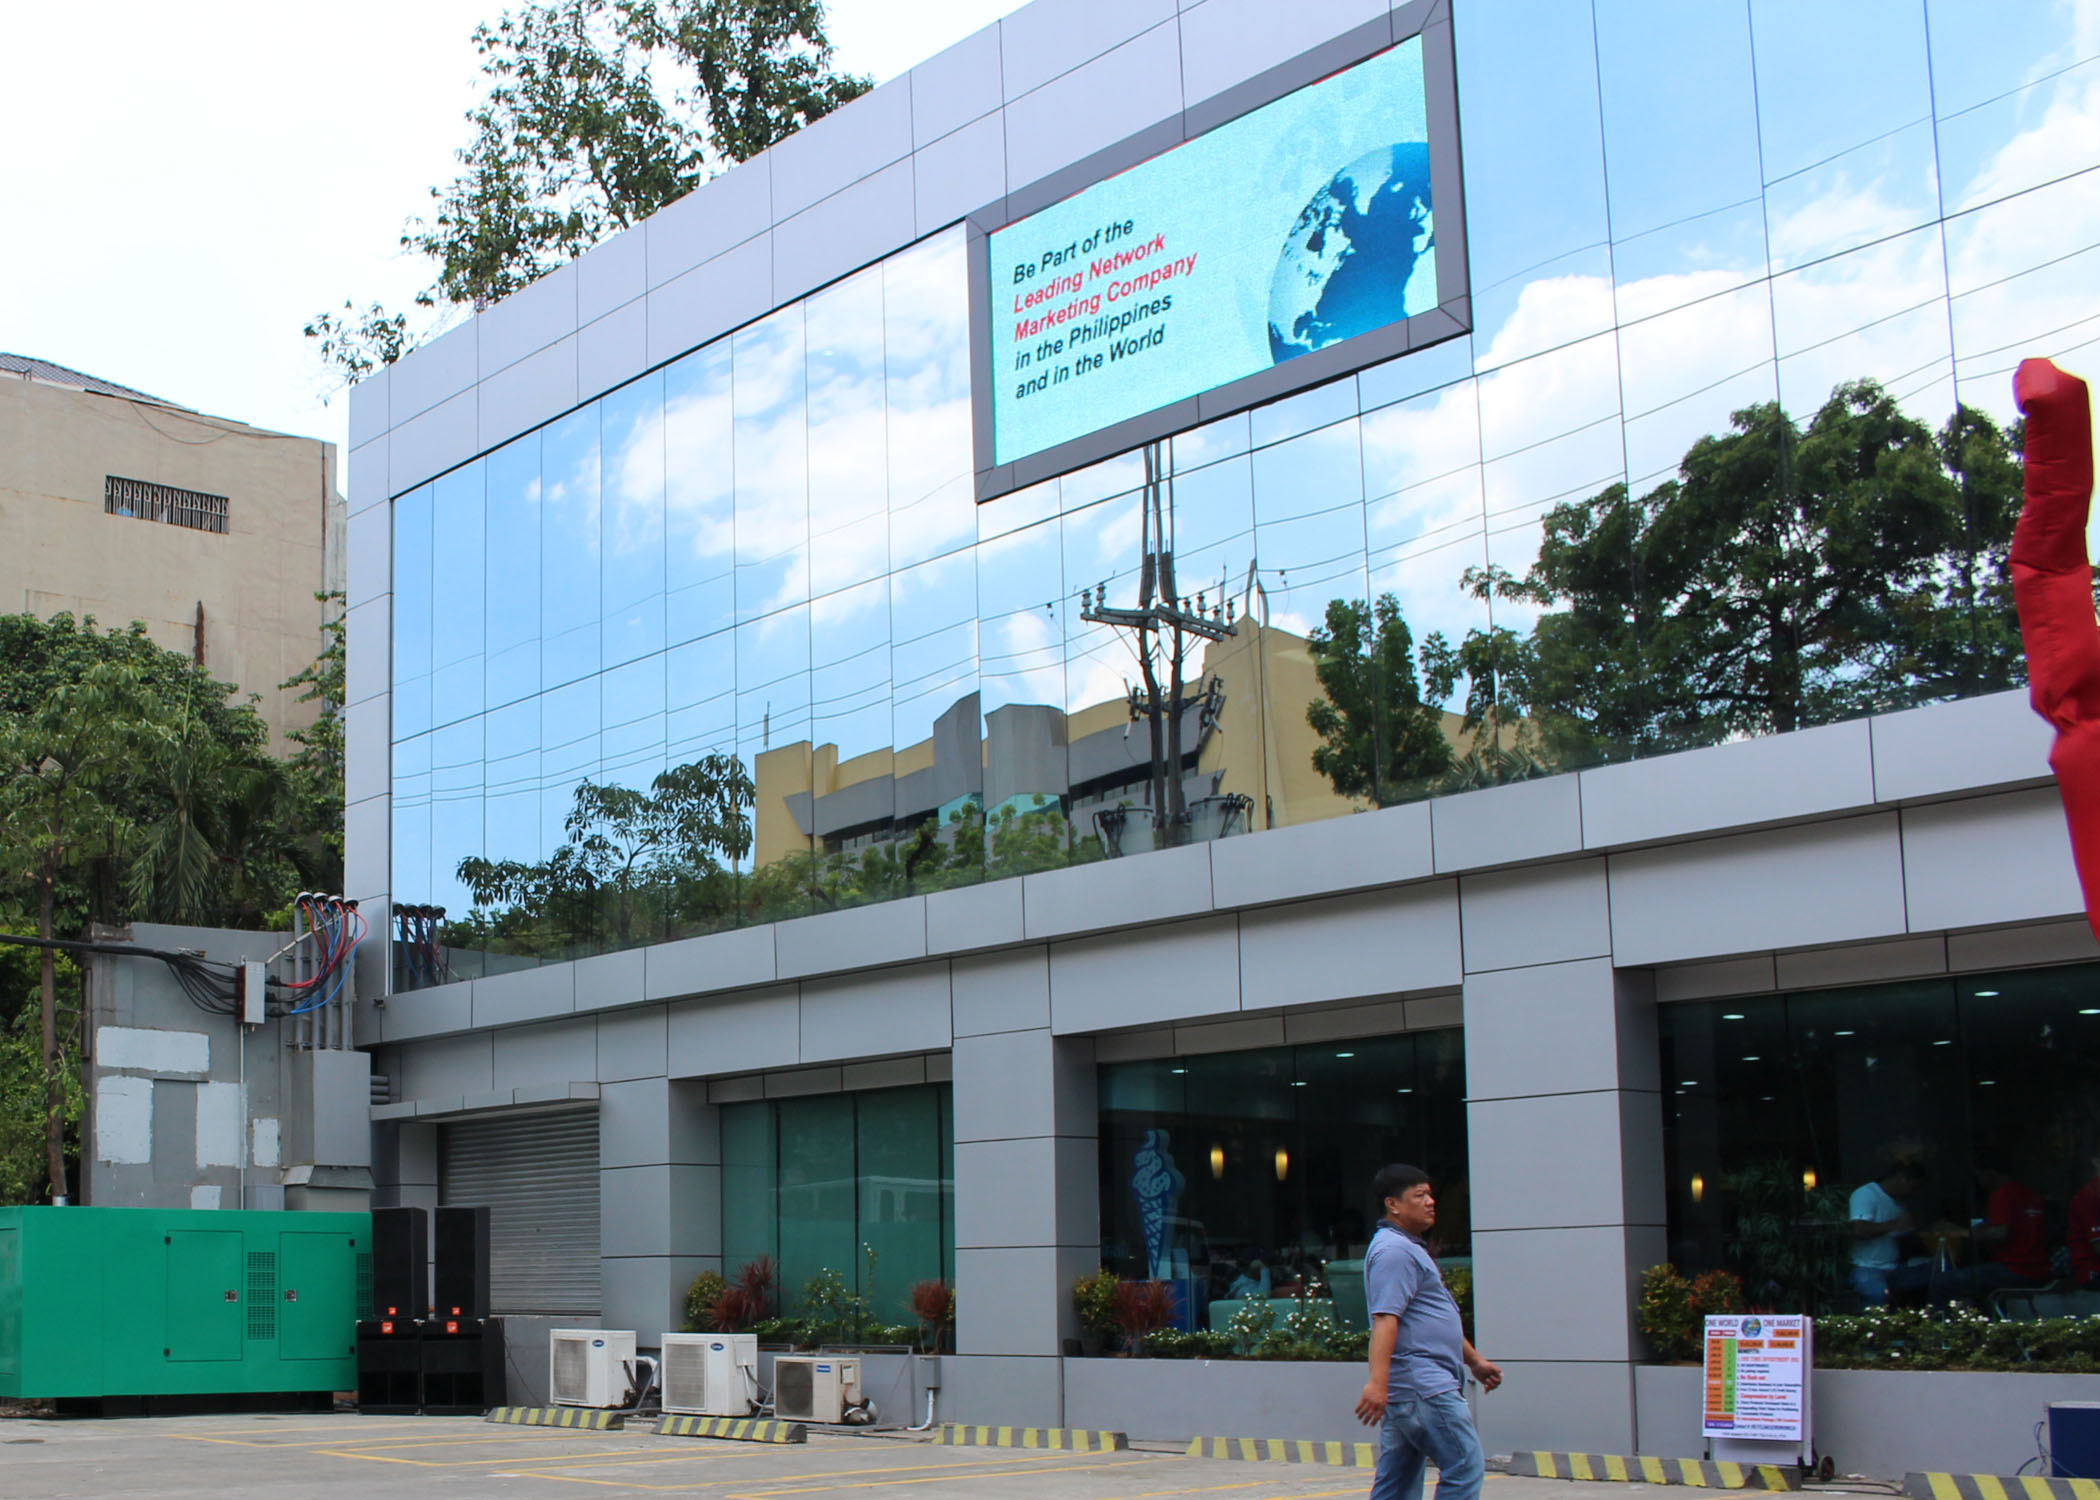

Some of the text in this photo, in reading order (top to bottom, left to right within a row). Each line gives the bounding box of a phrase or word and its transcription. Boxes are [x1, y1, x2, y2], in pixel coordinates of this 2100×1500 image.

[1013, 219, 1134, 284] Be Part of the
[1013, 233, 1165, 314] Leading Network
[1014, 253, 1198, 342] Marketing Company
[1014, 294, 1172, 371] in the Philippines
[1015, 323, 1165, 399] and in the World
